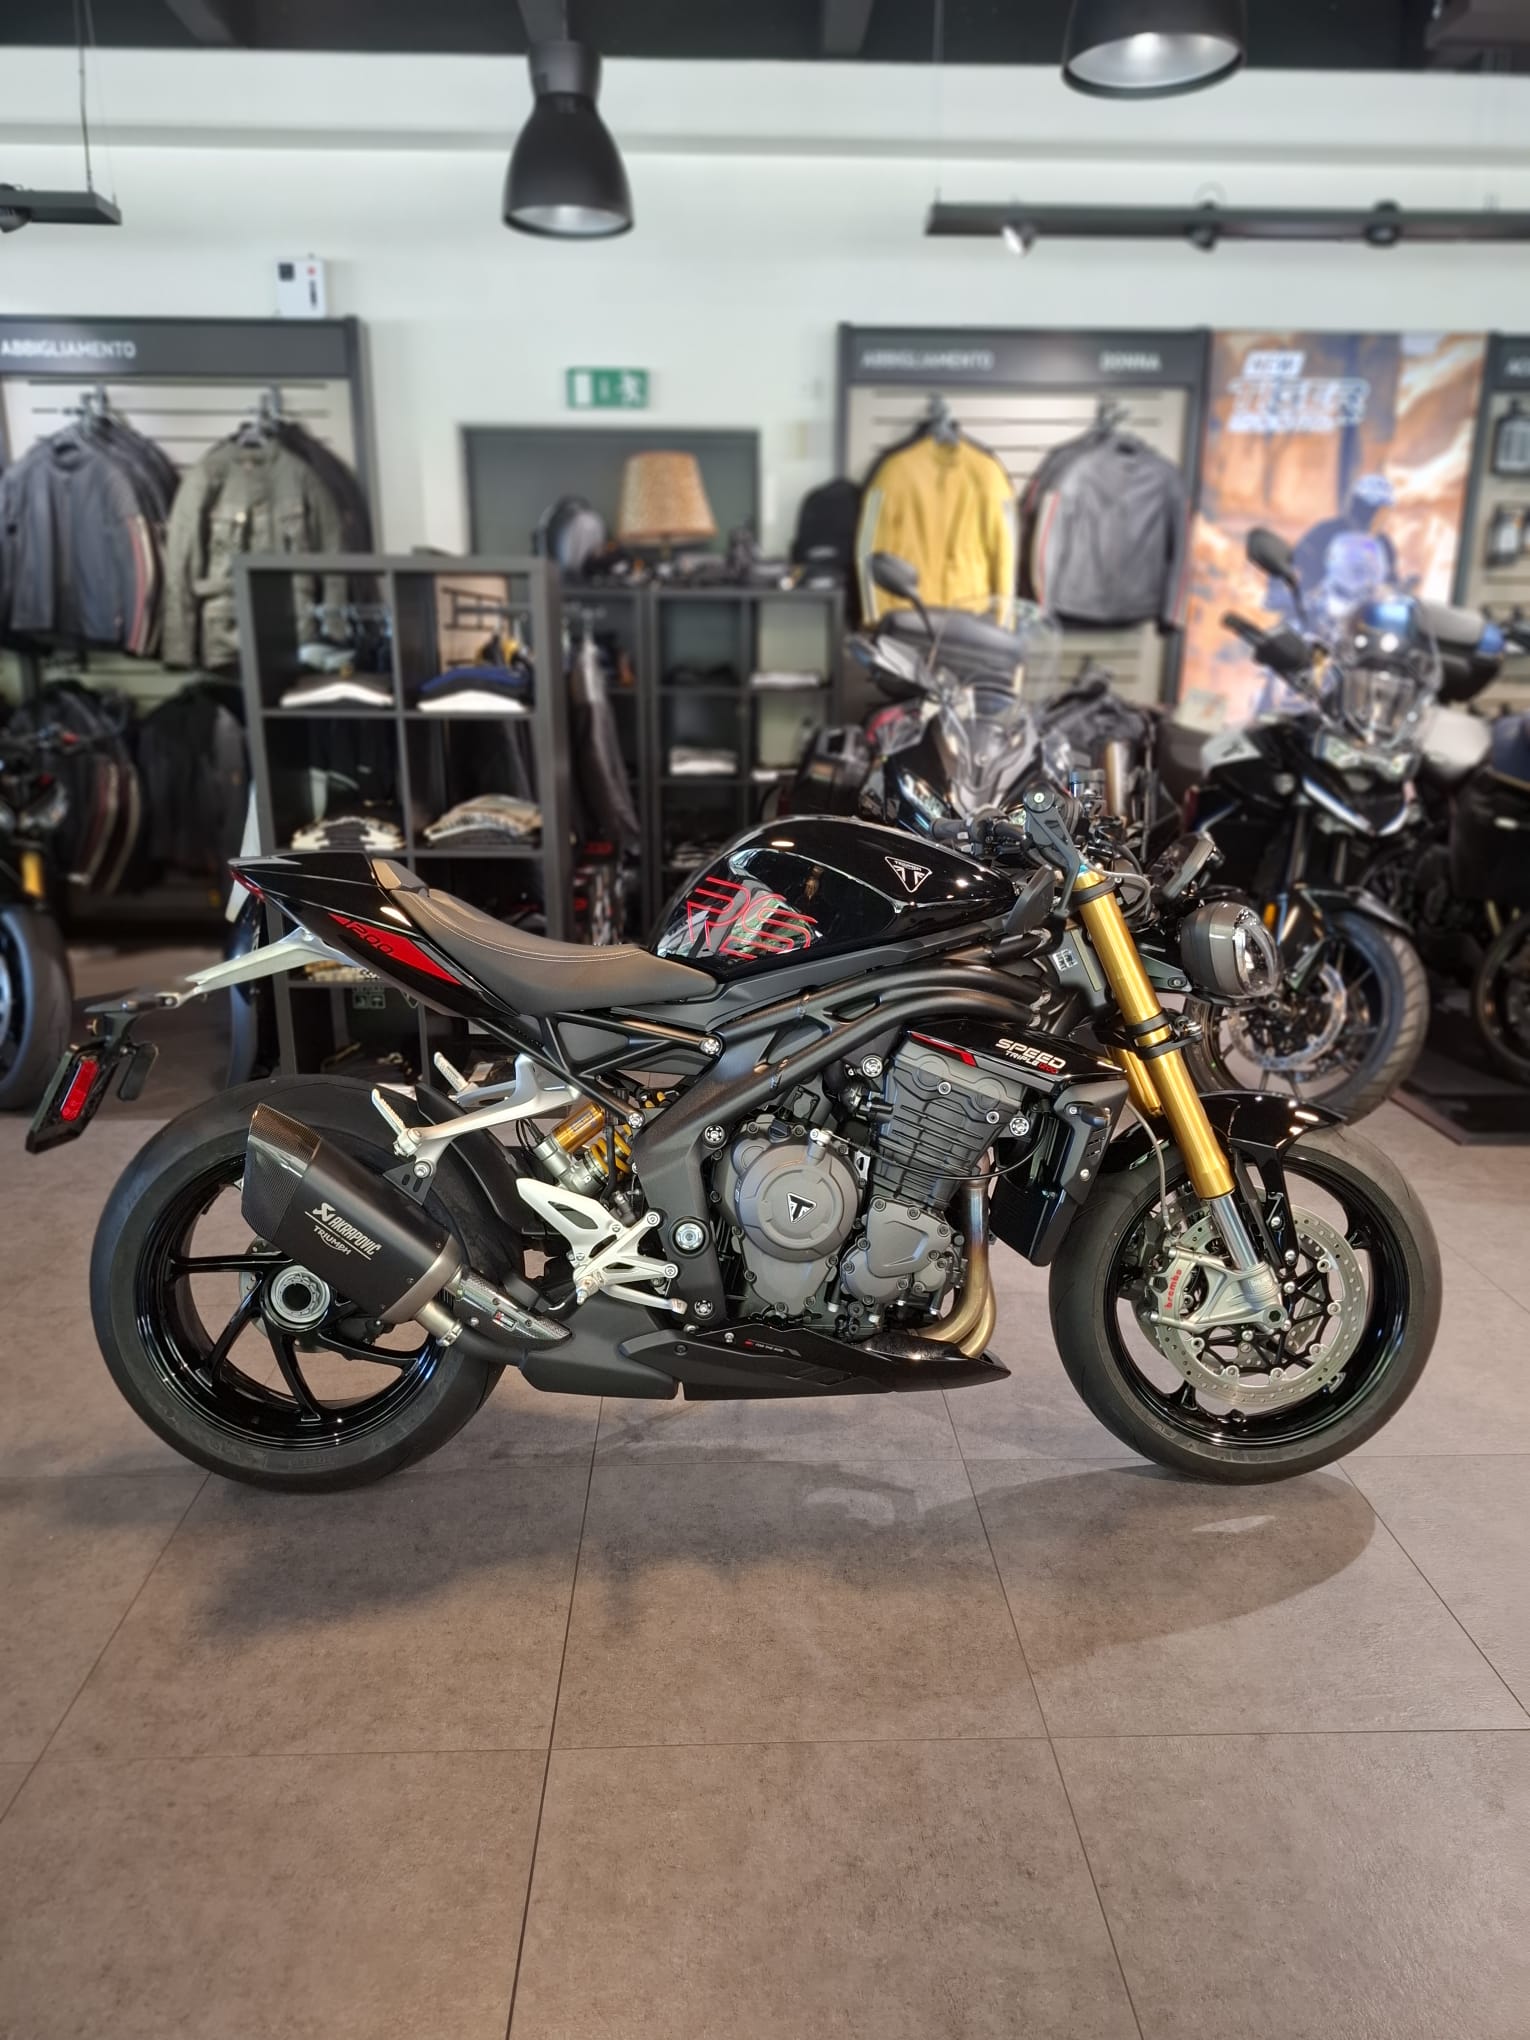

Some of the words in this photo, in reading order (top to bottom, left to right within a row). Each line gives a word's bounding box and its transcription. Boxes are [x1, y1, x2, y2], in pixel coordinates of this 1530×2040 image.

[1, 338, 137, 359] ABBIGLIAMENTO
[861, 350, 995, 371] ABBIGLIAMENTO
[995, 1038, 1067, 1069] SPEED
[313, 1225, 353, 1256] TRIUMPH
[1164, 1268, 1183, 1310] brembo
